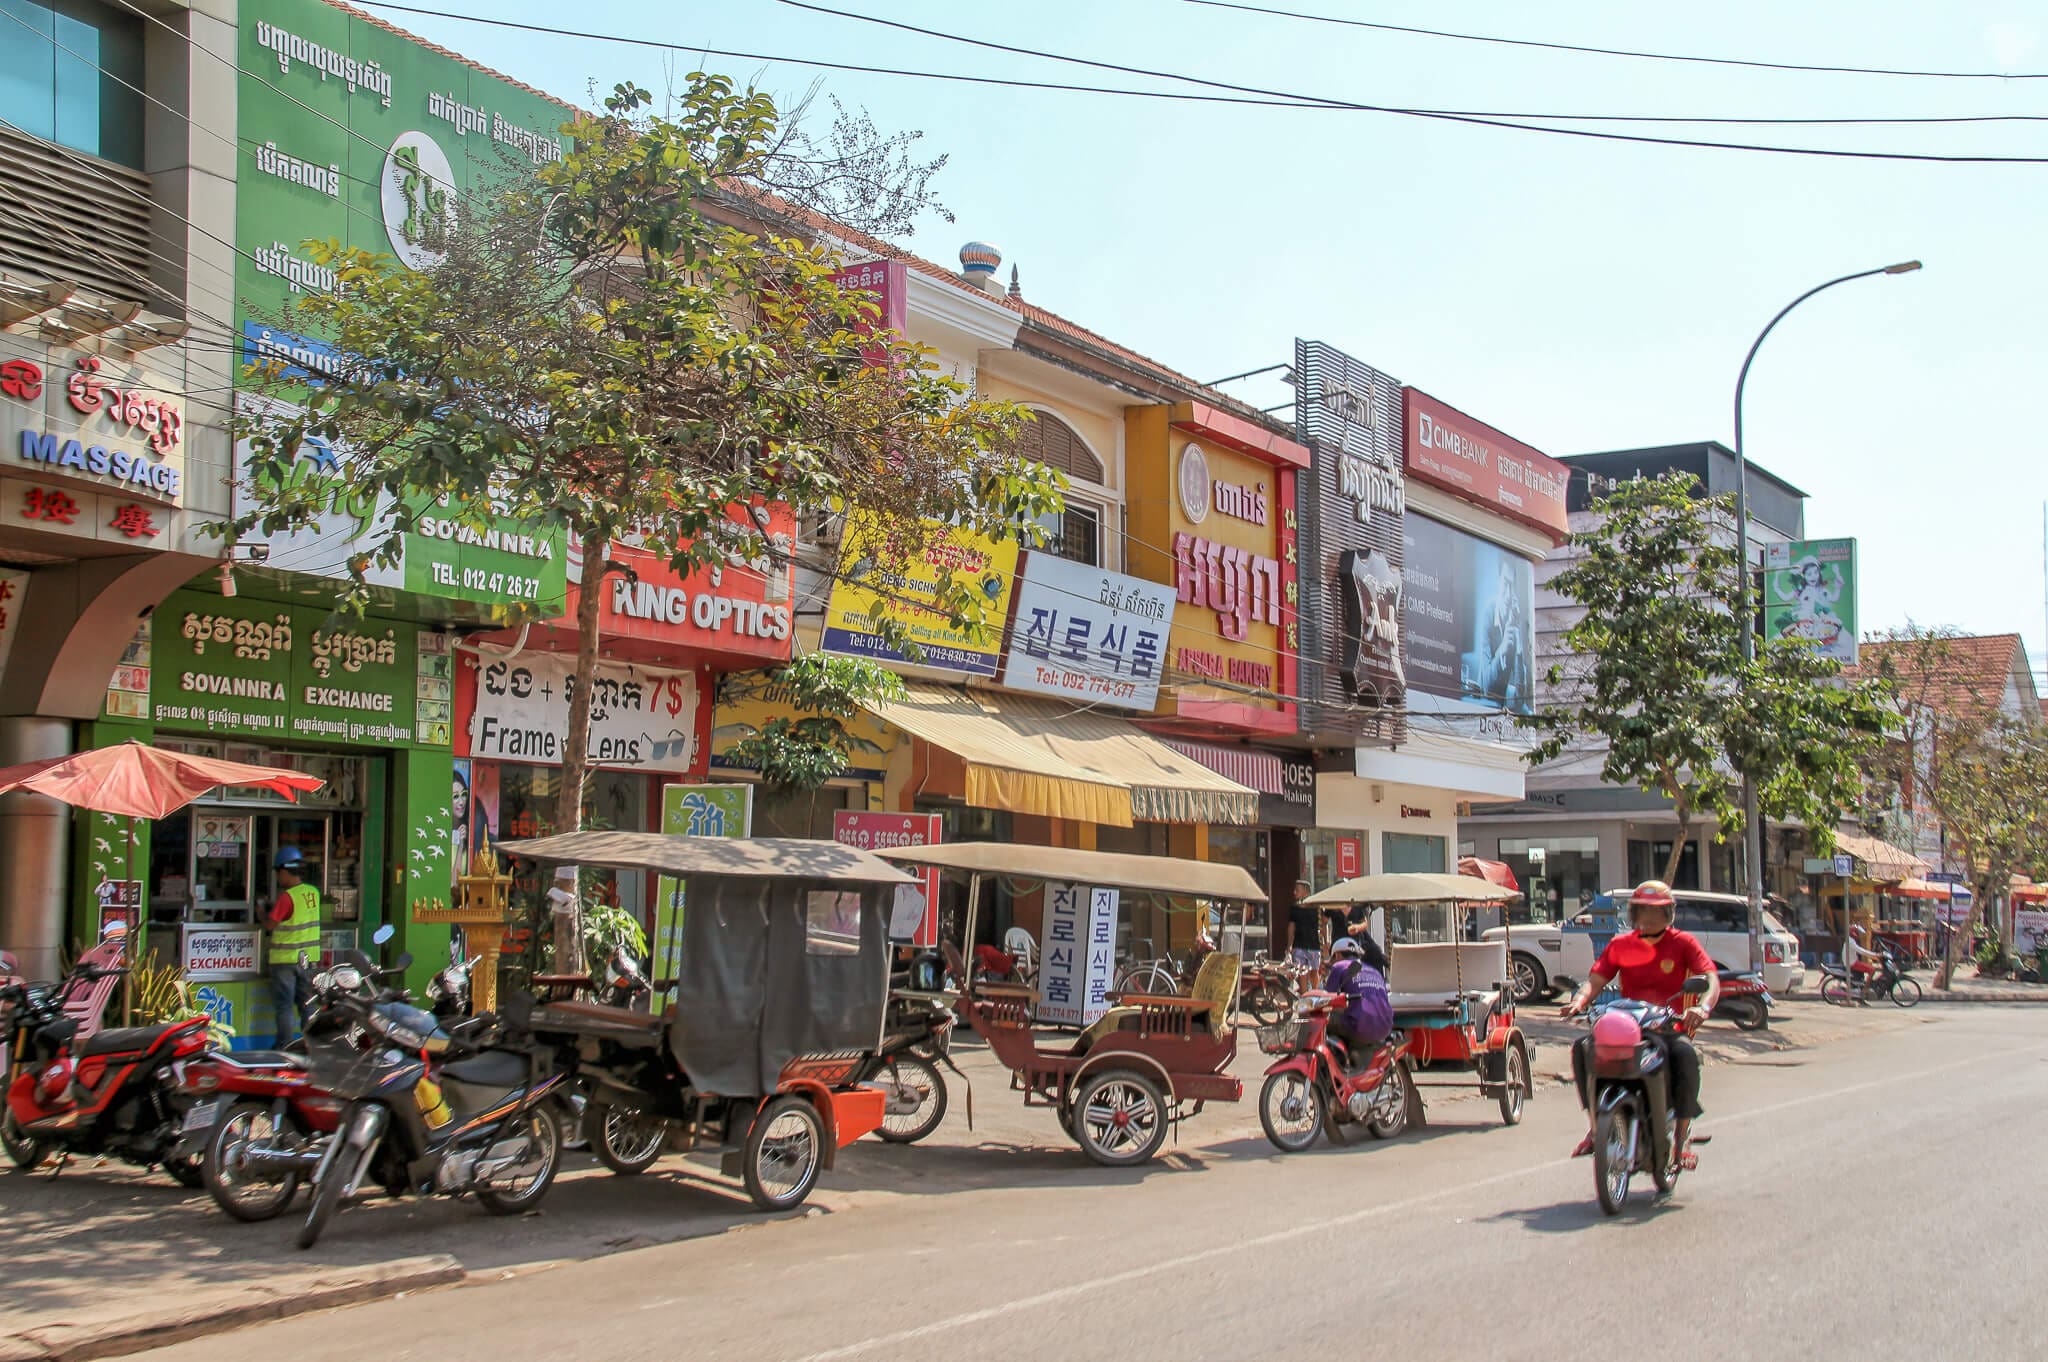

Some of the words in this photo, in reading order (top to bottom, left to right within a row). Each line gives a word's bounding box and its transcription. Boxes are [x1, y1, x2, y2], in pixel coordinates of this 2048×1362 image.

[20, 429, 181, 498] MASSAGE
[419, 516, 553, 560] SOVANNRA
[431, 562, 460, 587] TEL:
[463, 567, 486, 591] 012
[488, 573, 503, 594] 47
[507, 575, 522, 597] 26
[524, 578, 540, 599] 27
[612, 579, 687, 625] KING
[694, 594, 790, 641] OPTICS
[1408, 596, 1425, 615] CIMB
[849, 633, 866, 648] Tel:
[868, 637, 884, 650] 012
[1036, 667, 1059, 686] Tel:
[1062, 671, 1084, 690] 092
[1178, 647, 1225, 679] APSARA
[1228, 657, 1272, 688] BAKERY
[182, 672, 286, 701] SOVANNRA
[305, 686, 393, 712] EXCHANGE
[190, 706, 206, 720] 08
[480, 717, 556, 758] Frame
[587, 727, 641, 761] Lens
[1280, 763, 1313, 787] HOES
[1284, 790, 1313, 808] Making
[190, 956, 252, 970] EXCHANGE
